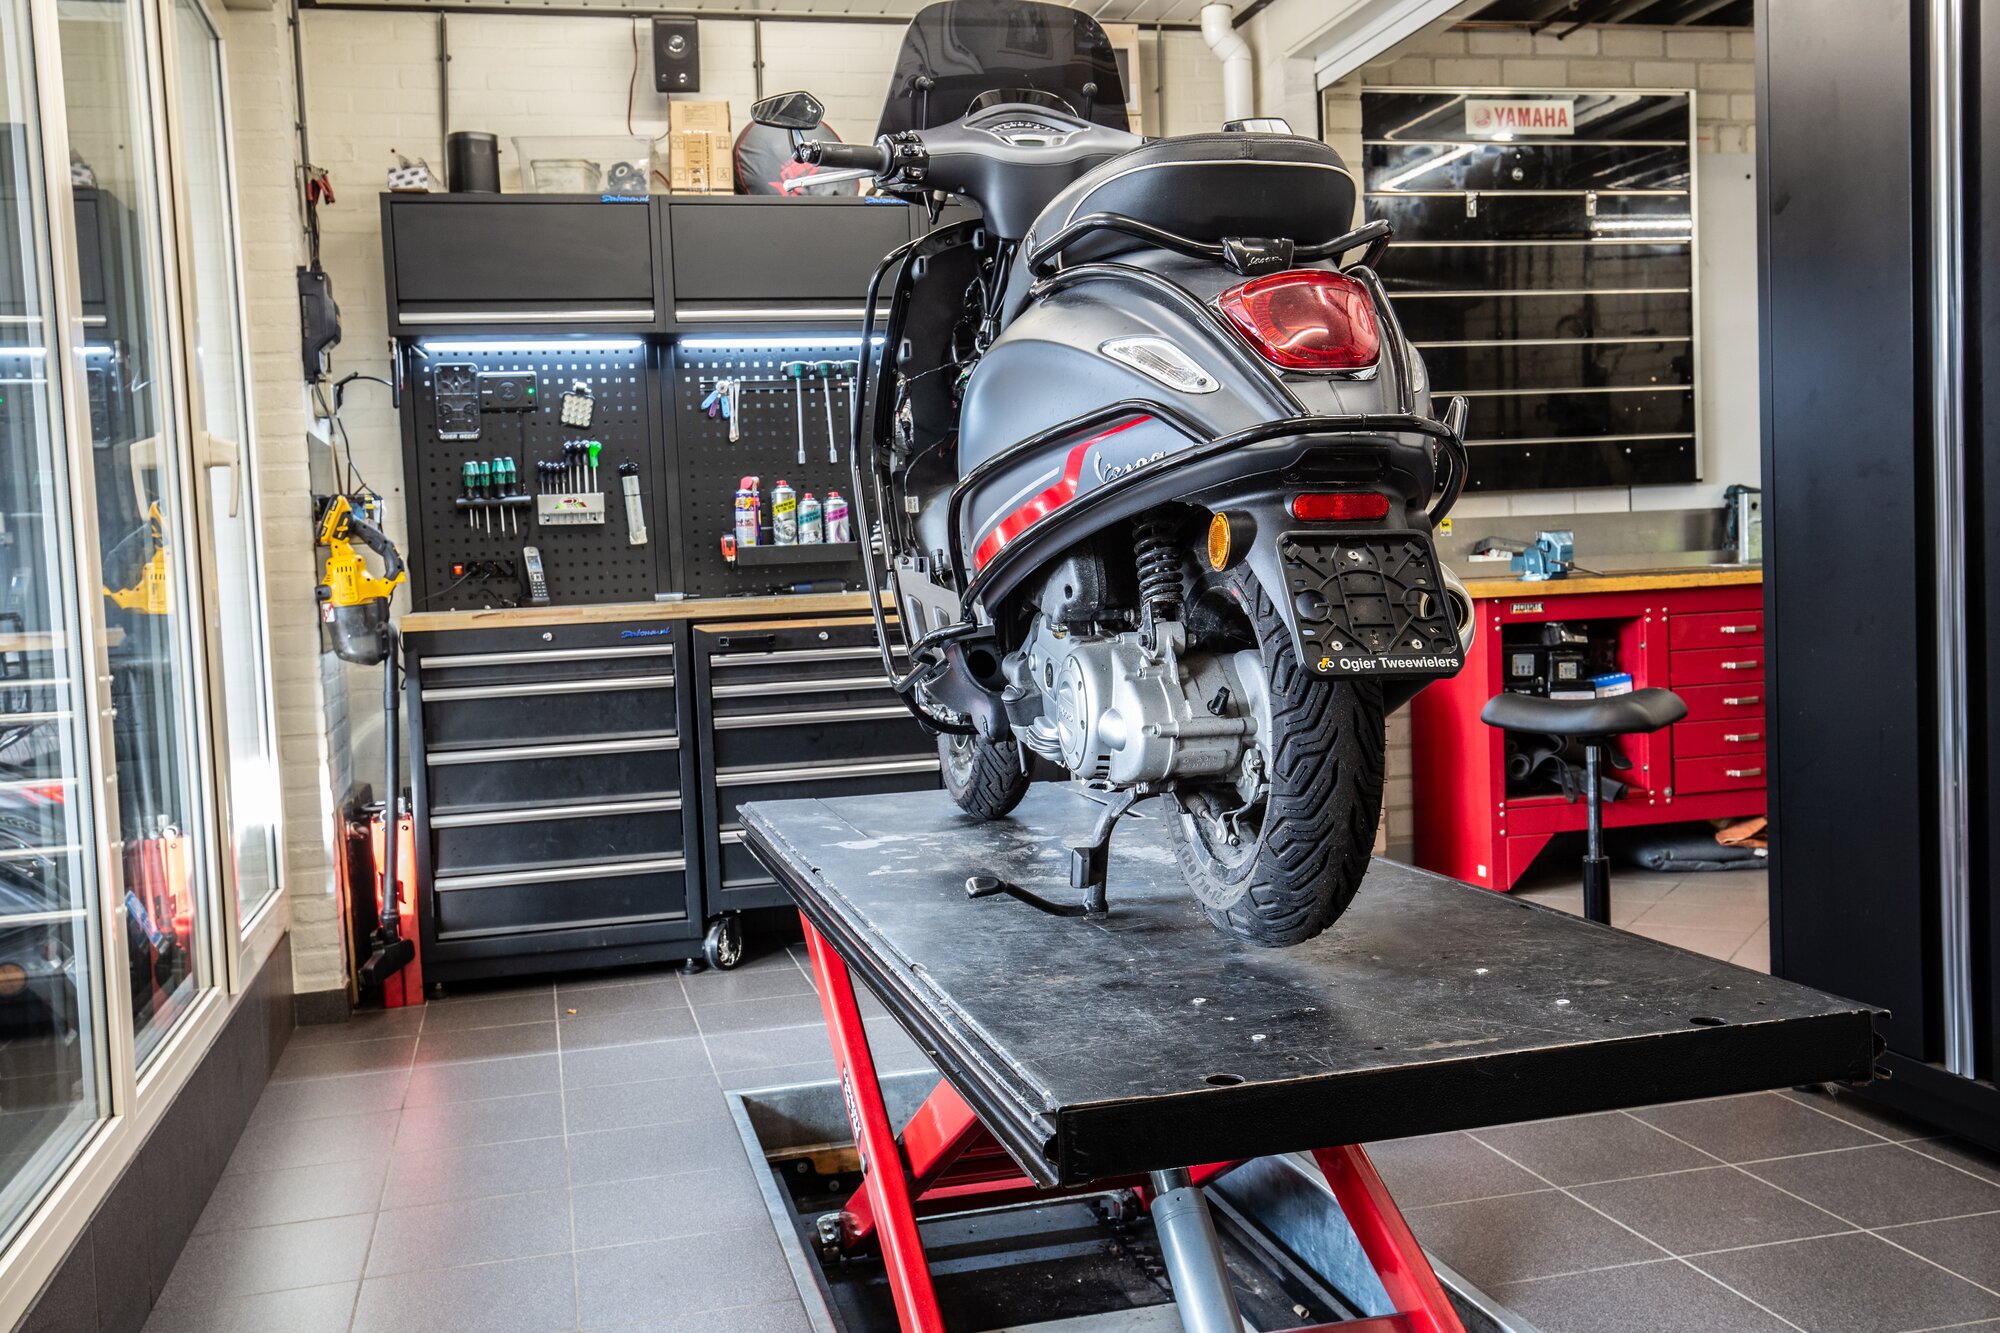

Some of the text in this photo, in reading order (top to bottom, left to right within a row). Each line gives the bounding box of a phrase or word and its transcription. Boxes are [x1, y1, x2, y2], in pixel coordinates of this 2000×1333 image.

[1494, 107, 1568, 128] YAMAHA
[1339, 656, 1459, 672] Ogier Tweewielers
